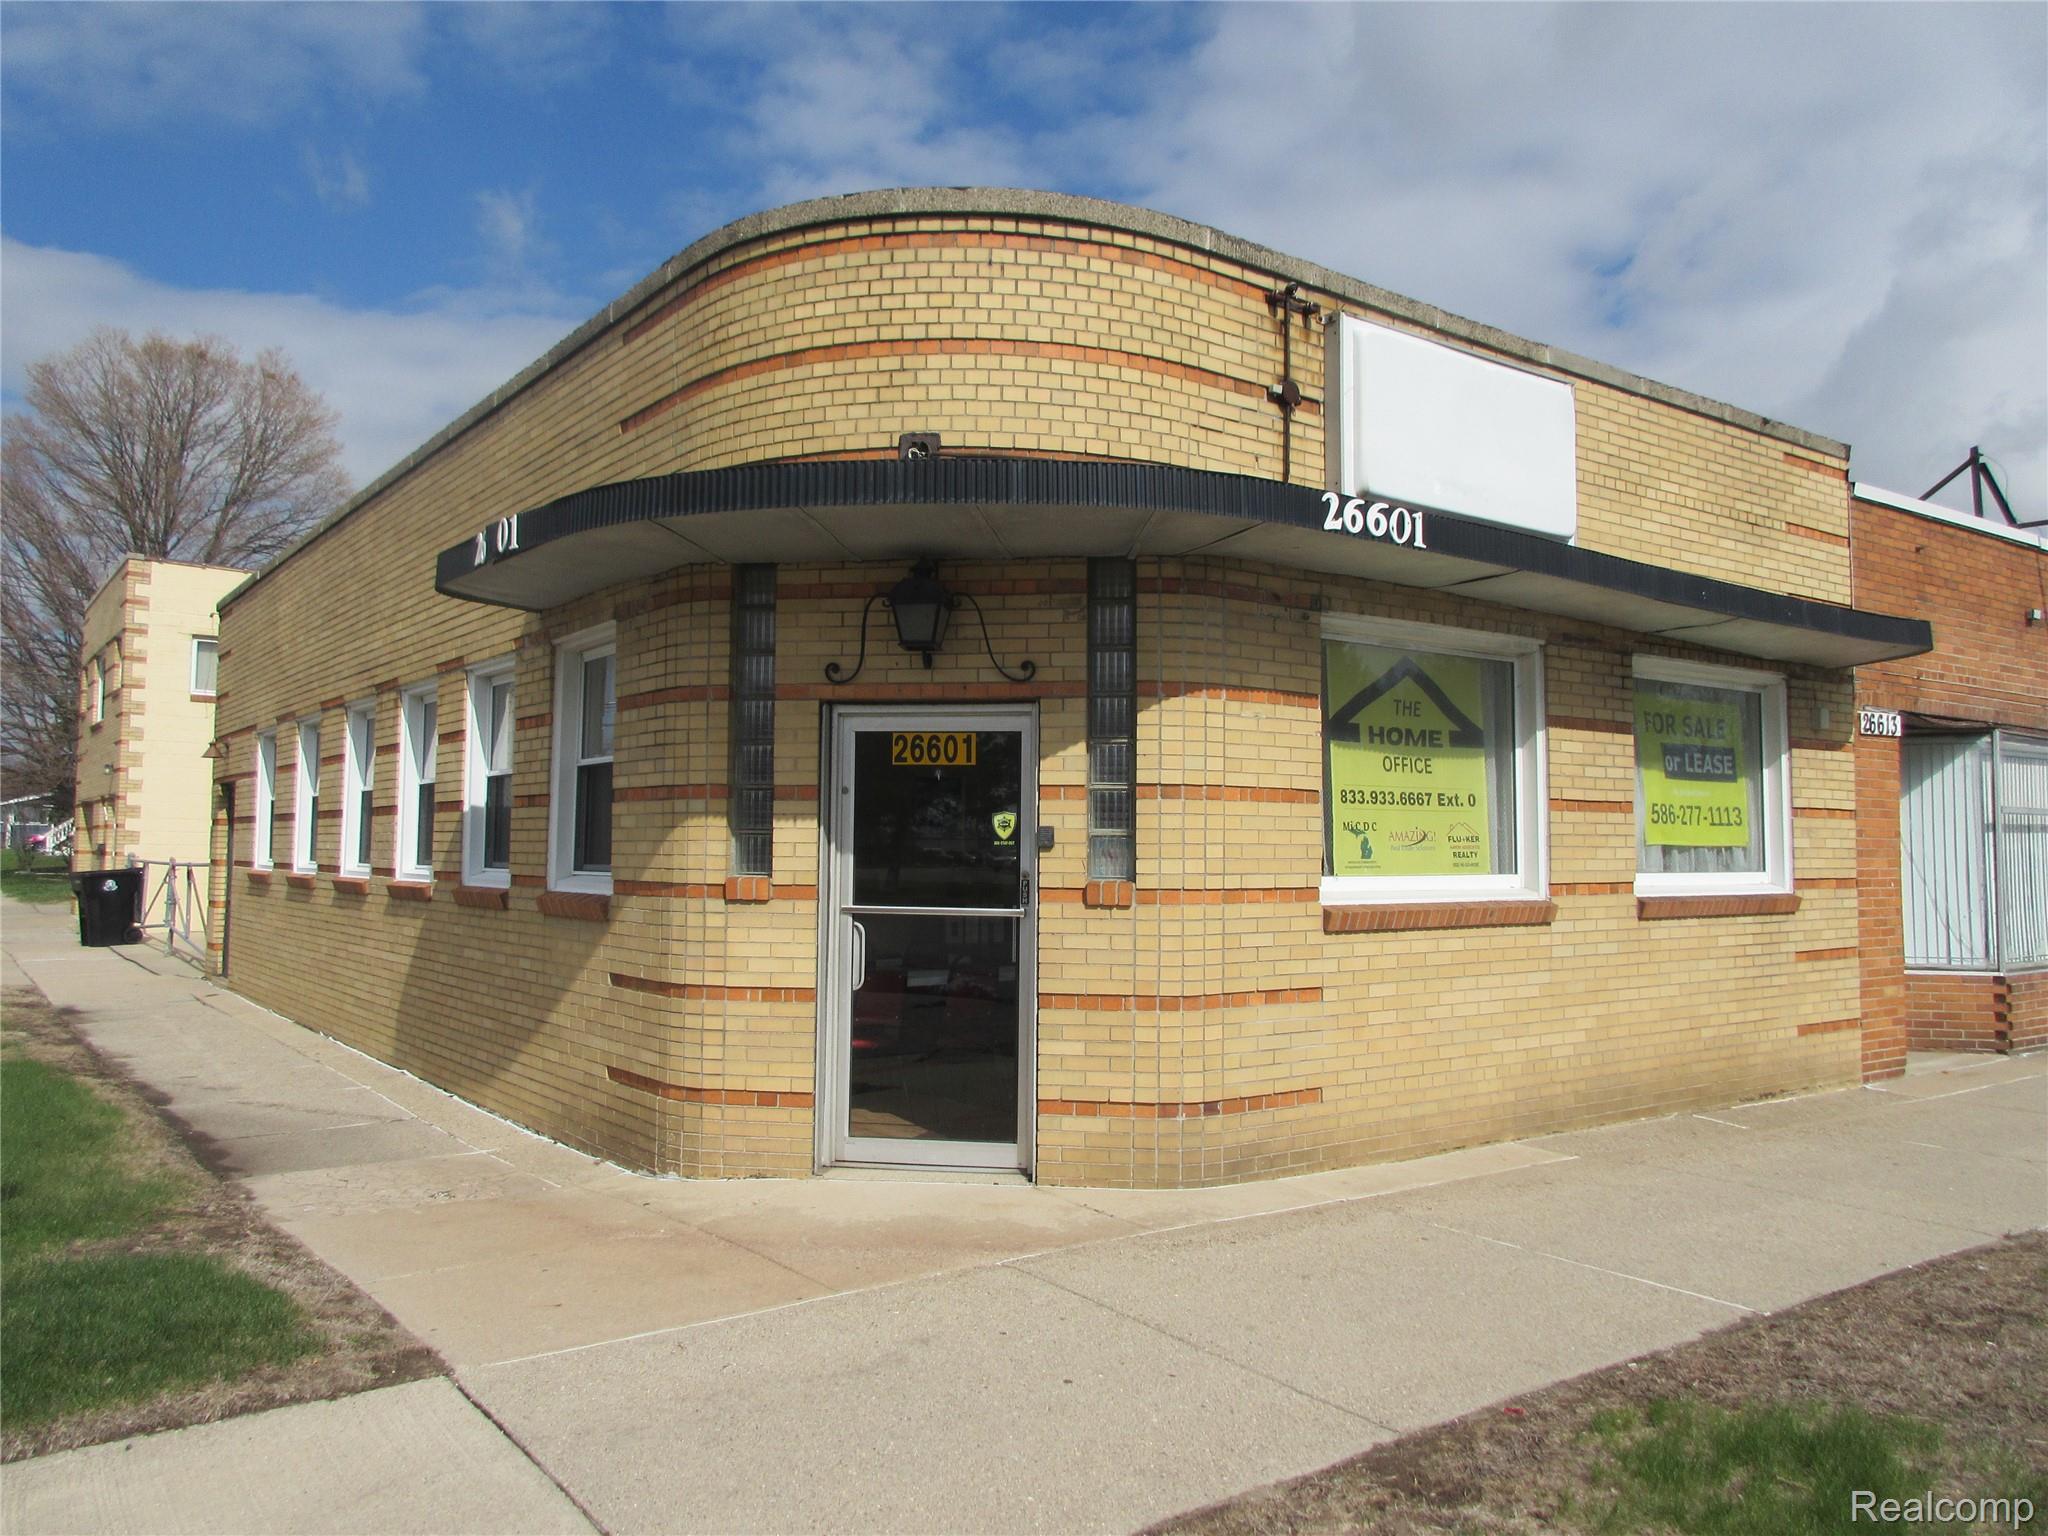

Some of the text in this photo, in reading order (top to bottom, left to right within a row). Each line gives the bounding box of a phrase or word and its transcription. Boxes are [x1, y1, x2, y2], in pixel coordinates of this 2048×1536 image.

[1321, 492, 1427, 549] 26601
[1393, 699, 1421, 717] THE
[1643, 710, 1726, 740] FOR SALE
[1863, 712, 1898, 735] 26613
[1368, 725, 1443, 748] HOME
[893, 734, 973, 763] 26601
[1382, 755, 1433, 774] OFFICE
[1664, 751, 1734, 775] or LEASE
[1340, 789, 1477, 808] 833.933.6667 Ext. 0
[1650, 802, 1744, 827] 586-277-1113
[1452, 851, 1479, 859] REALTY
